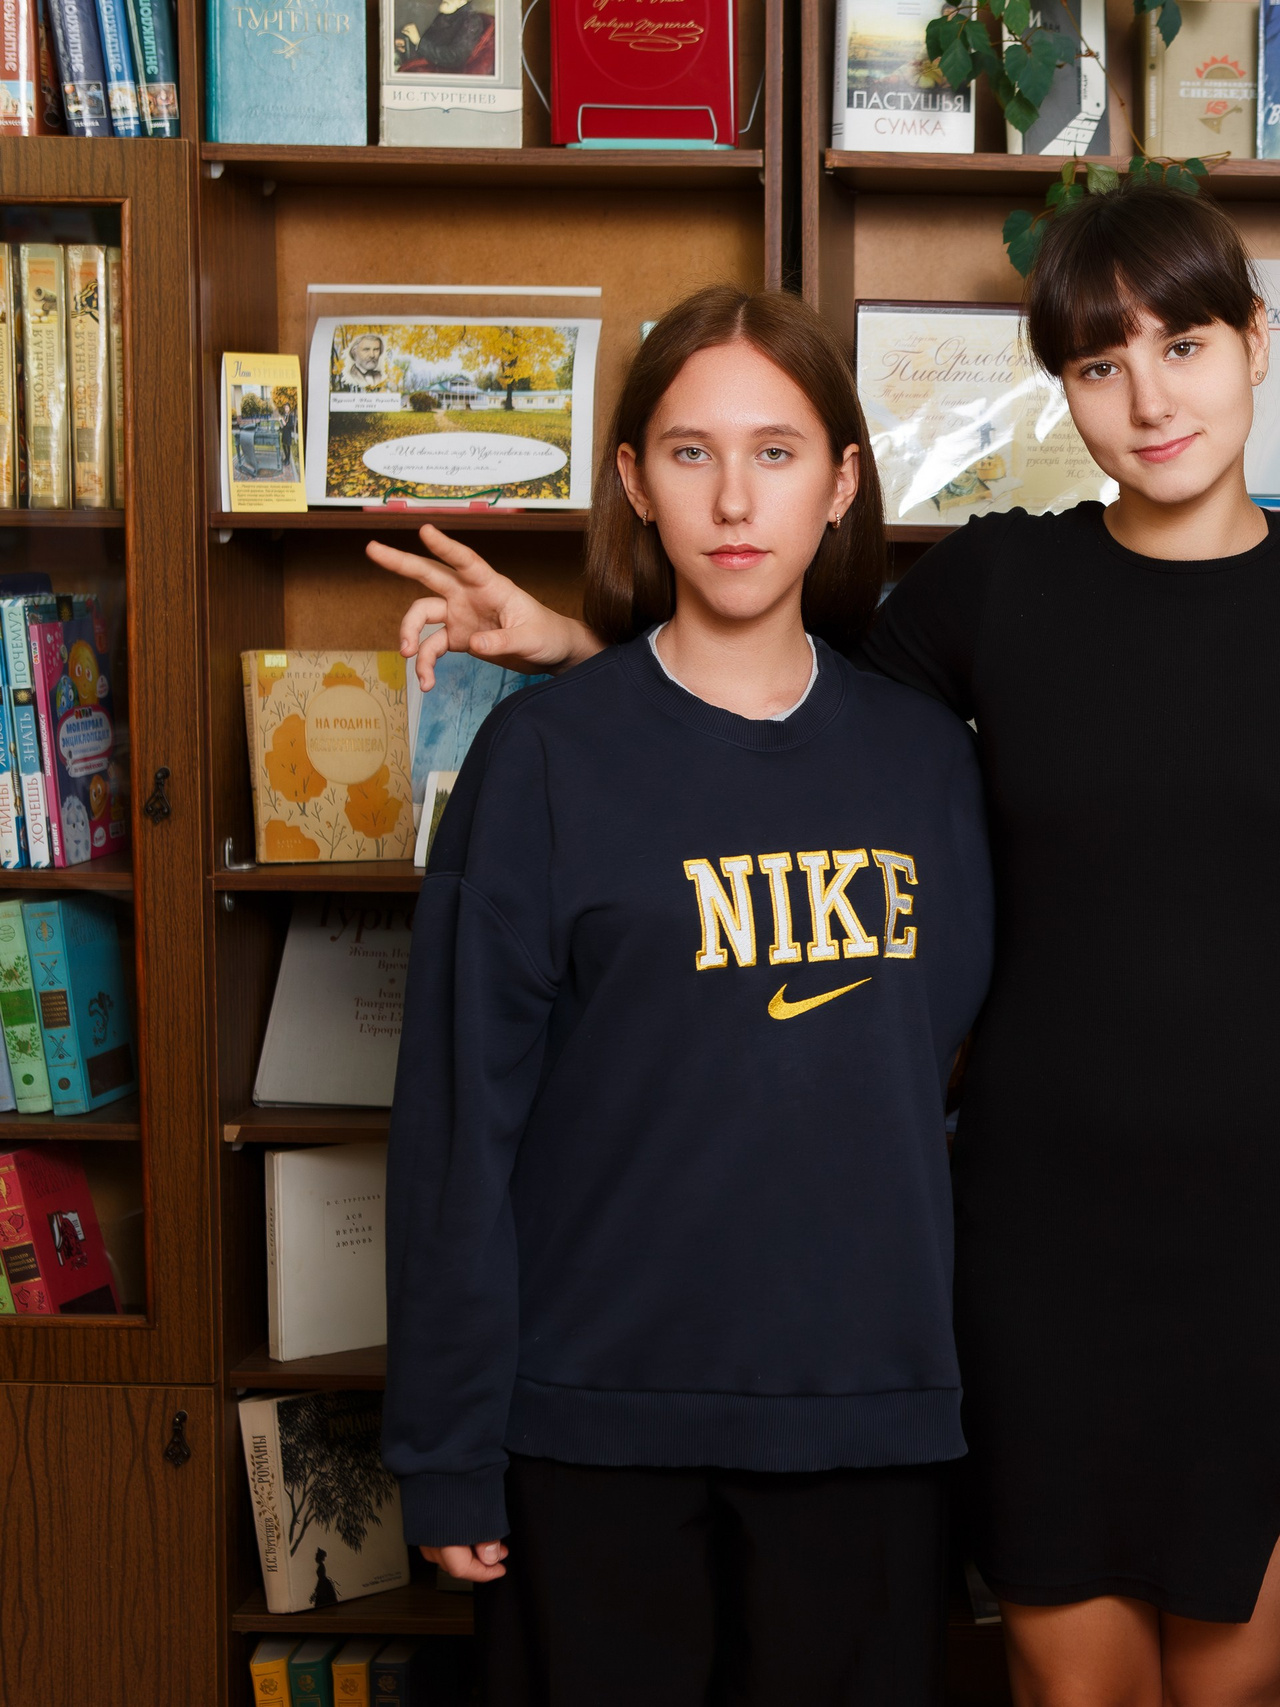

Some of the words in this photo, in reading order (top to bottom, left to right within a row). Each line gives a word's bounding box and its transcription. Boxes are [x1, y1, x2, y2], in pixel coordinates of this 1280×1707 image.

[852, 90, 966, 112] ПАСТУШЬЯ
[874, 117, 946, 137] СУМКА
[33, 328, 44, 418] ШКОЛЬНАЯ
[76, 330, 86, 421] ШКОЛЬНАЯ
[874, 349, 1016, 384] Писатели
[11, 611, 27, 684] ПОЧЕМУ?
[20, 712, 36, 763] ЗНАТЬ
[66, 720, 80, 734] МОЯ
[81, 718, 103, 732] ПЕРВАЯ
[315, 718, 330, 729] НА
[333, 717, 381, 730] РОДИНЕ
[27, 777, 45, 845] ХОЧЕШЬ
[683, 849, 919, 971] NIKE
[378, 987, 401, 999] Ivan
[370, 1012, 387, 1021] vie
[335, 1226, 373, 1236] ПЕРВАЯ
[335, 1237, 373, 1248] ЛЮБОВЬ
[252, 1435, 270, 1484] РОМАНЫ
